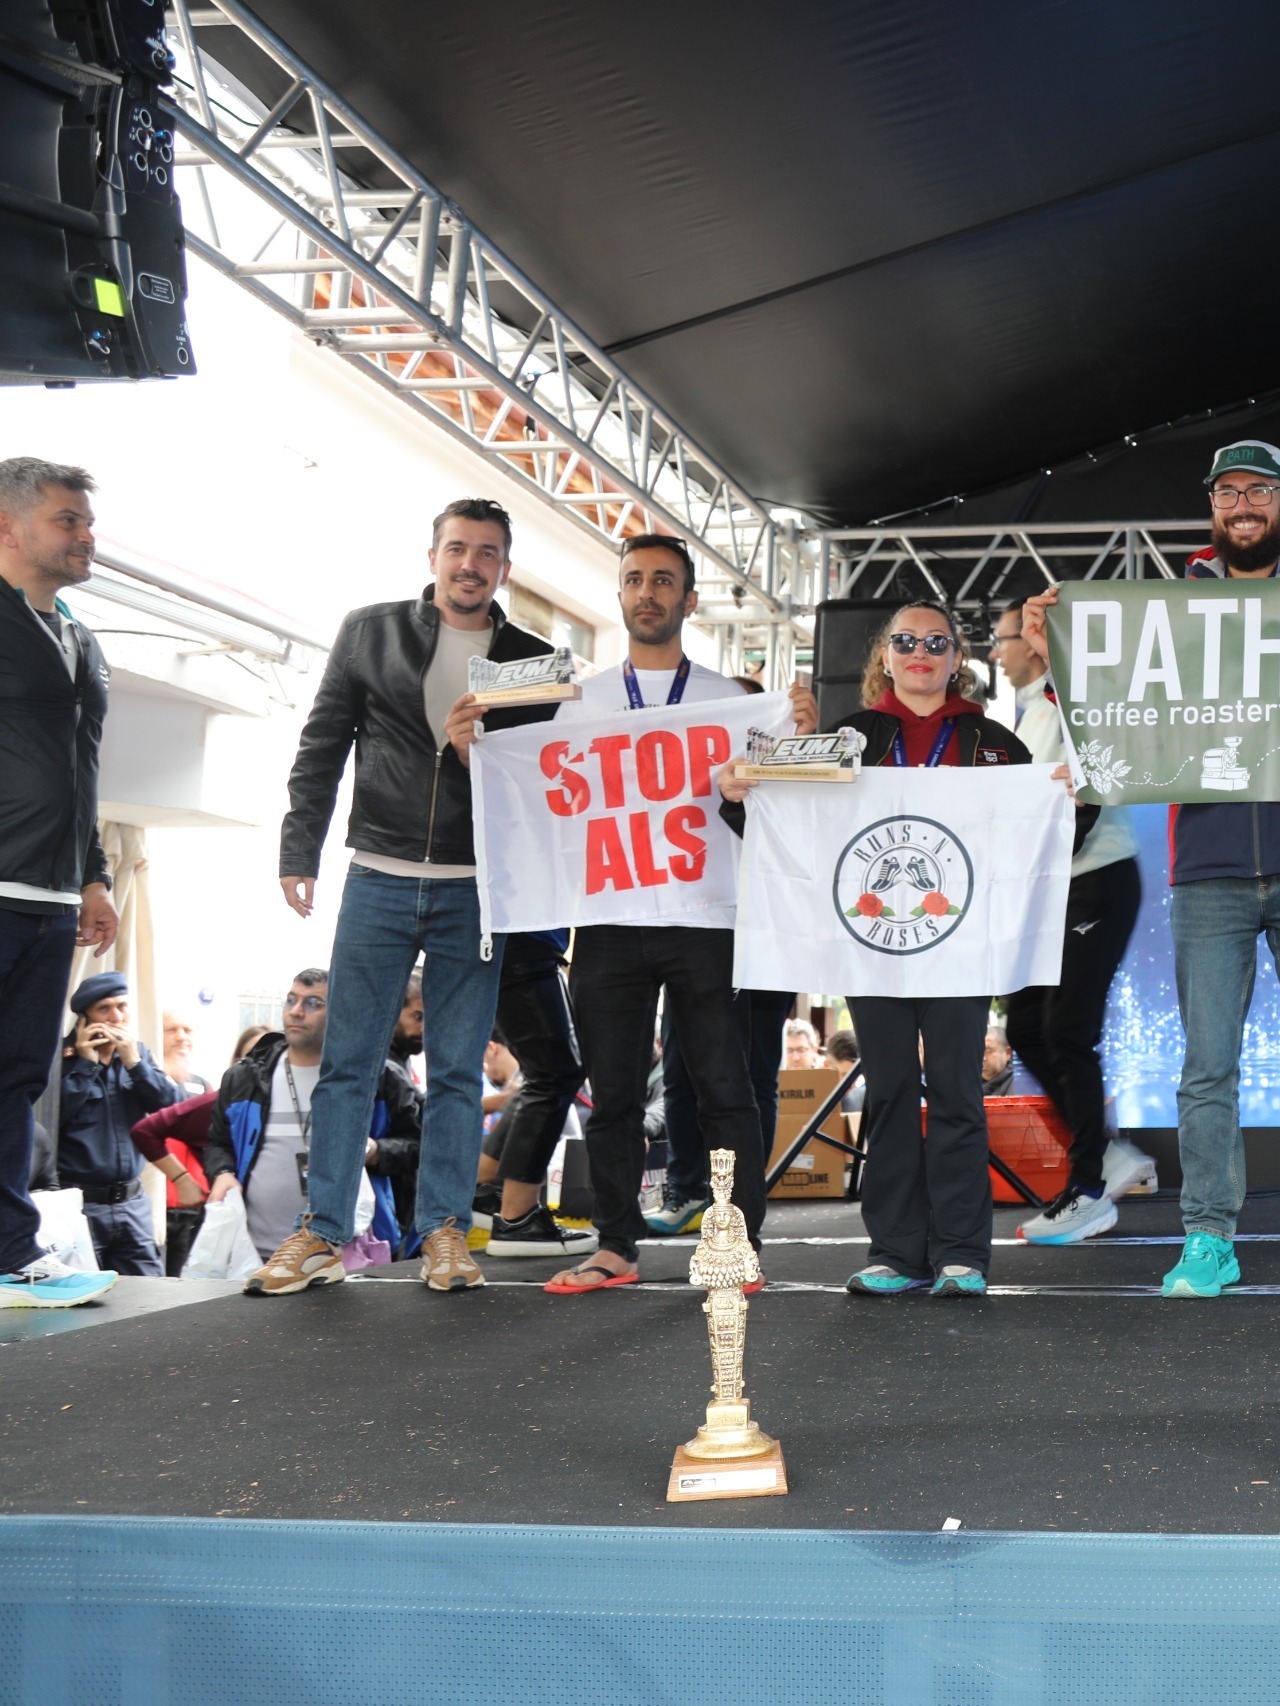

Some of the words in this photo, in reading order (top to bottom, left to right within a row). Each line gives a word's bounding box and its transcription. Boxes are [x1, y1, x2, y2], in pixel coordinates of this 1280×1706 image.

[1227, 449, 1255, 463] PATH
[496, 660, 551, 684] EUM
[1070, 702, 1159, 727] coffee
[771, 737, 839, 757] EUM
[539, 725, 731, 817] STOP
[586, 805, 708, 896] ALS
[853, 824, 911, 863] RUNS
[866, 919, 939, 948] ROSES
[780, 1089, 815, 1099] KIRILIR
